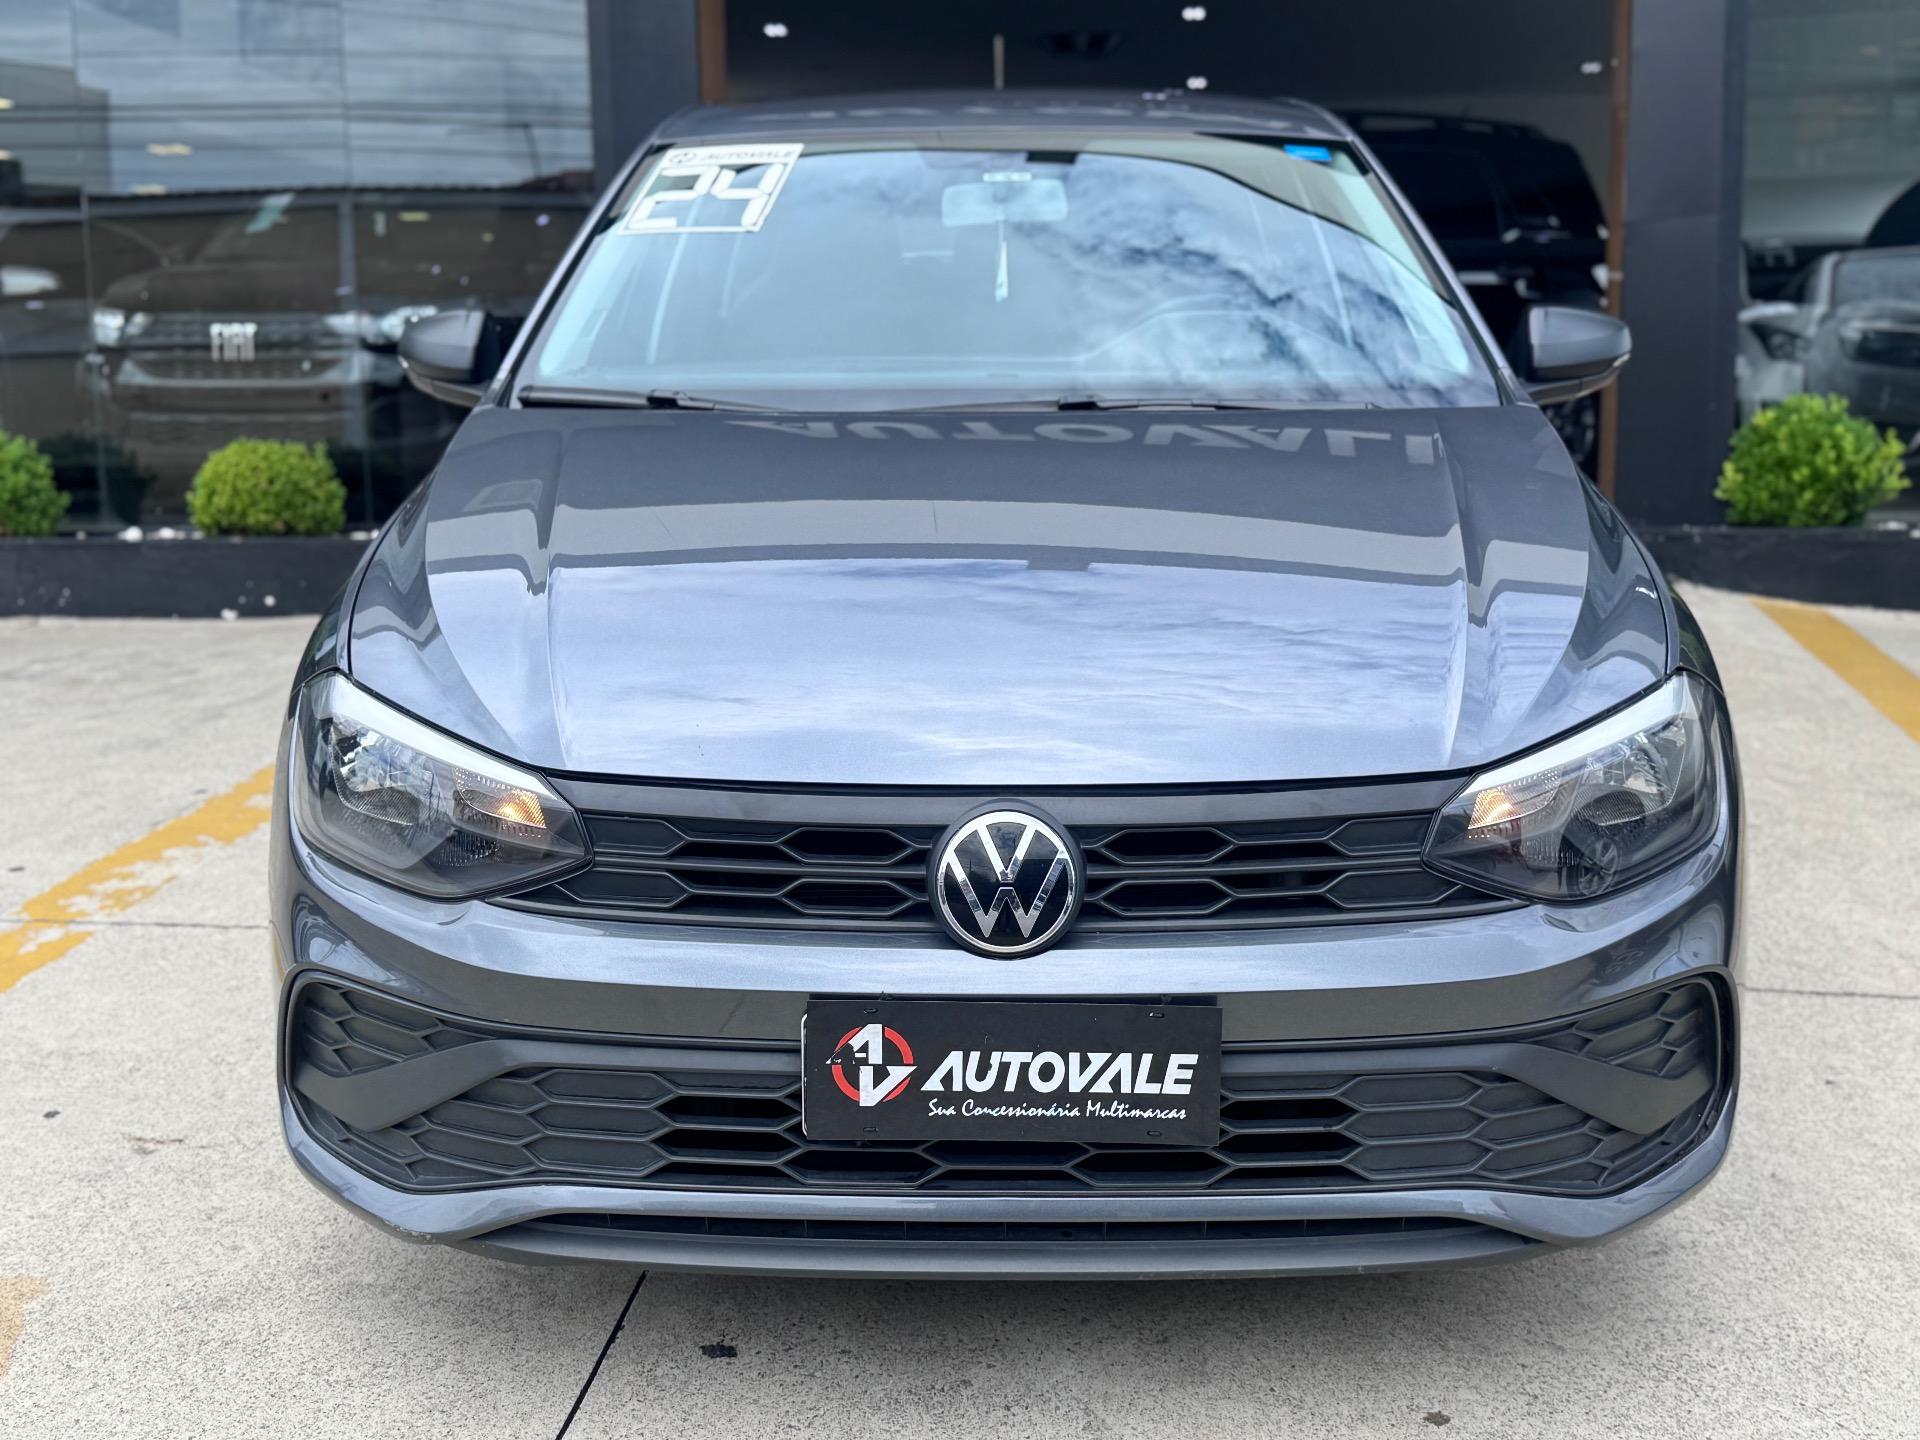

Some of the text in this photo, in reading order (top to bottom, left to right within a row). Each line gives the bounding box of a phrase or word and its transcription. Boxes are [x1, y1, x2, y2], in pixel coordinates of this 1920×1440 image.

[702, 151, 796, 162] AUTOVALE
[628, 163, 784, 228] 24
[920, 1050, 1200, 1095] AUTOVALE
[928, 1099, 1188, 1120] Sua Concessionária Multimarcas
